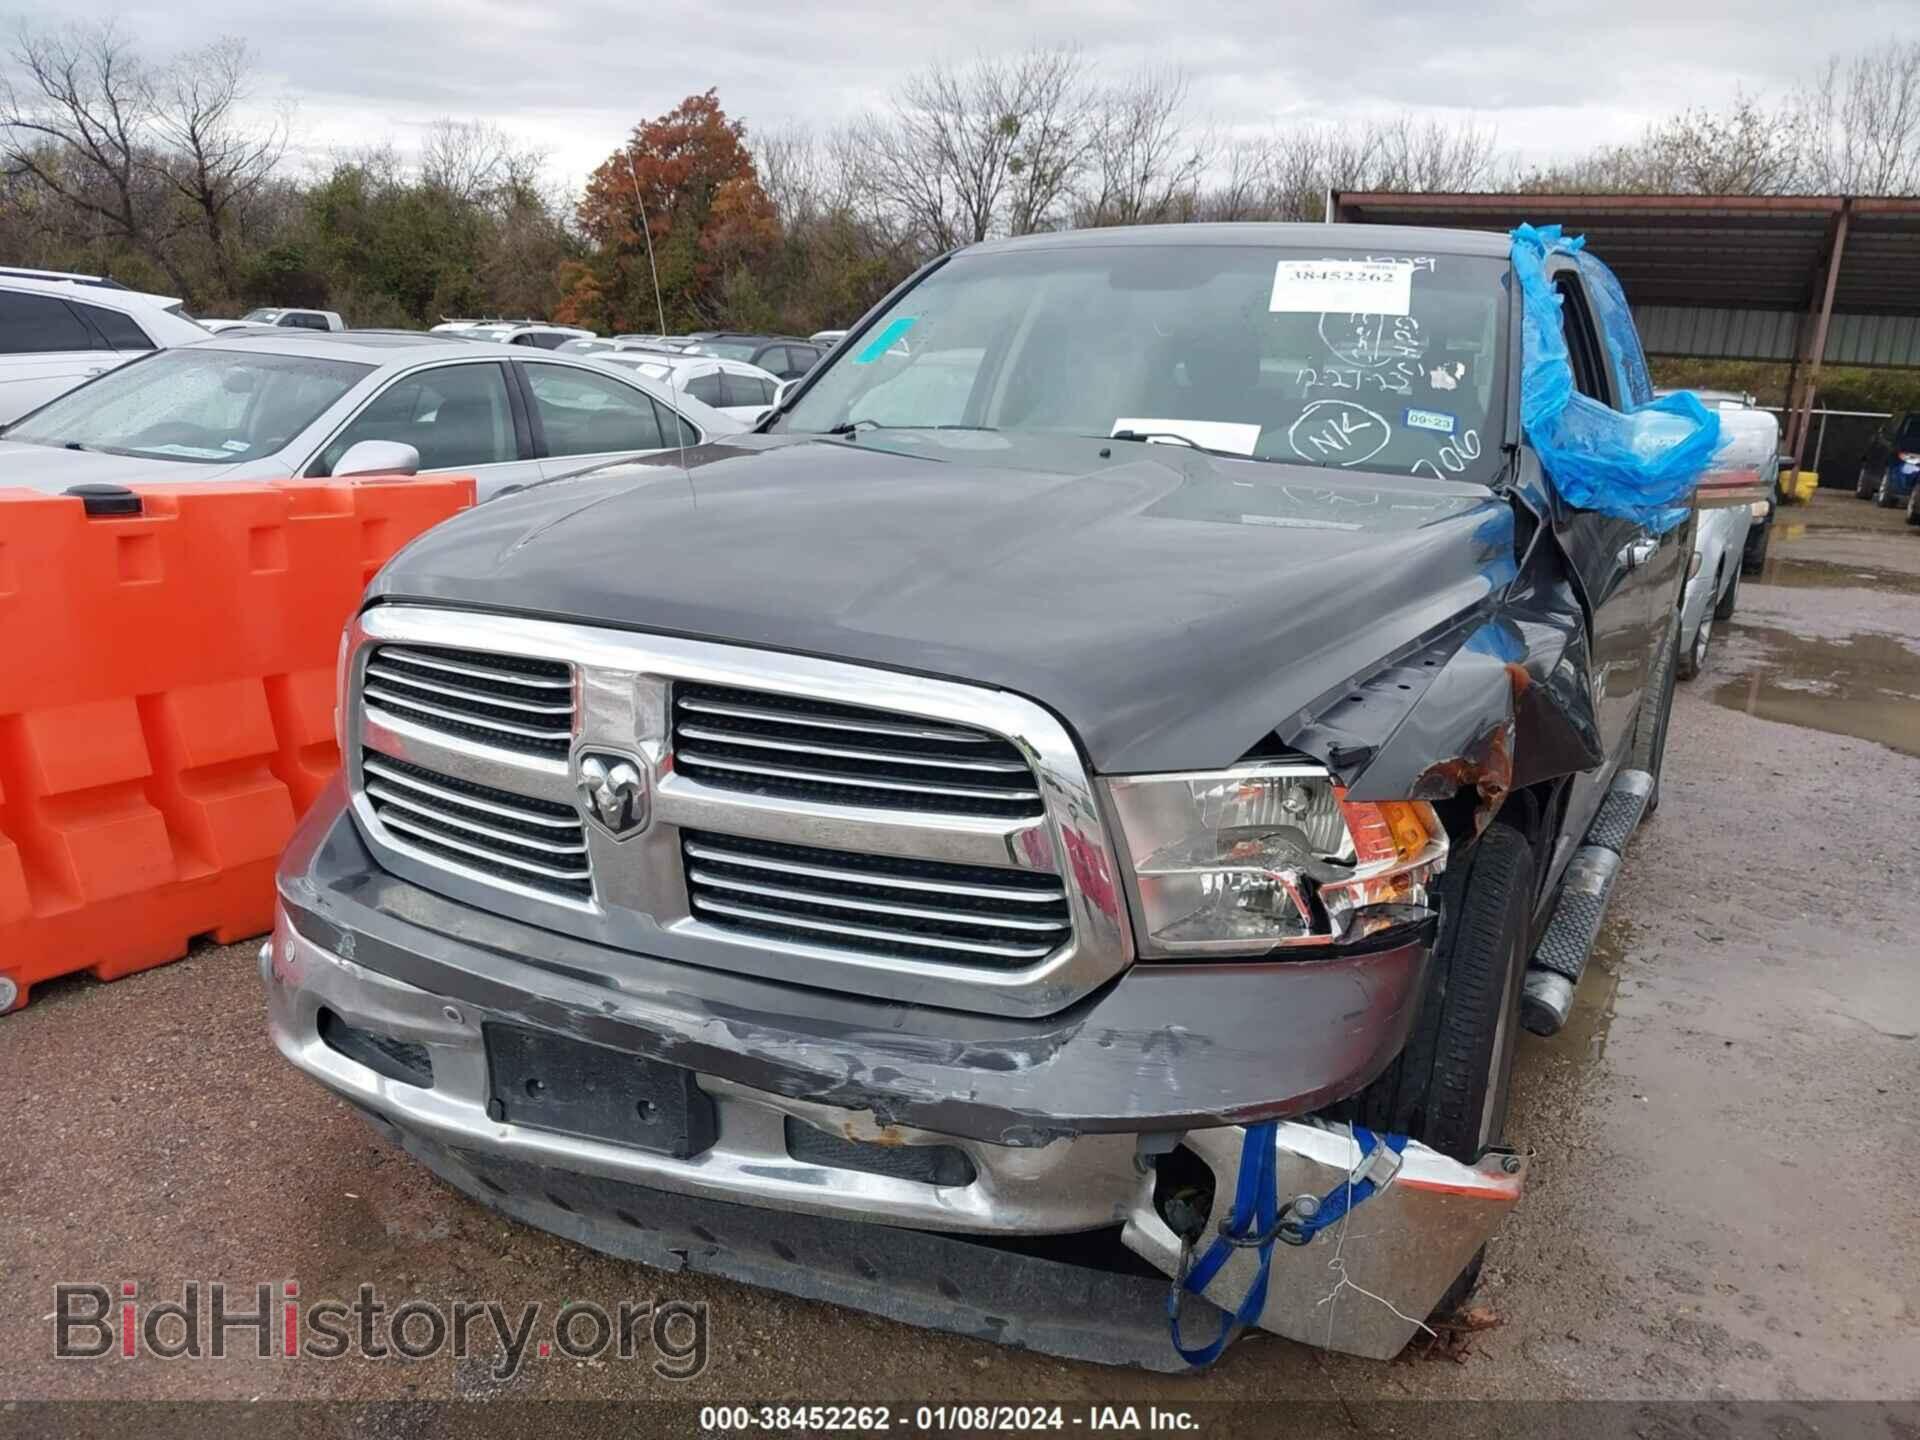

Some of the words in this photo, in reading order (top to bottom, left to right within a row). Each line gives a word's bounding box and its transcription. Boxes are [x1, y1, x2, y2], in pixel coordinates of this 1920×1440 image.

[1289, 270, 1394, 283] 38452262
[1309, 412, 1371, 453] NK
[1411, 429, 1481, 480] 706
